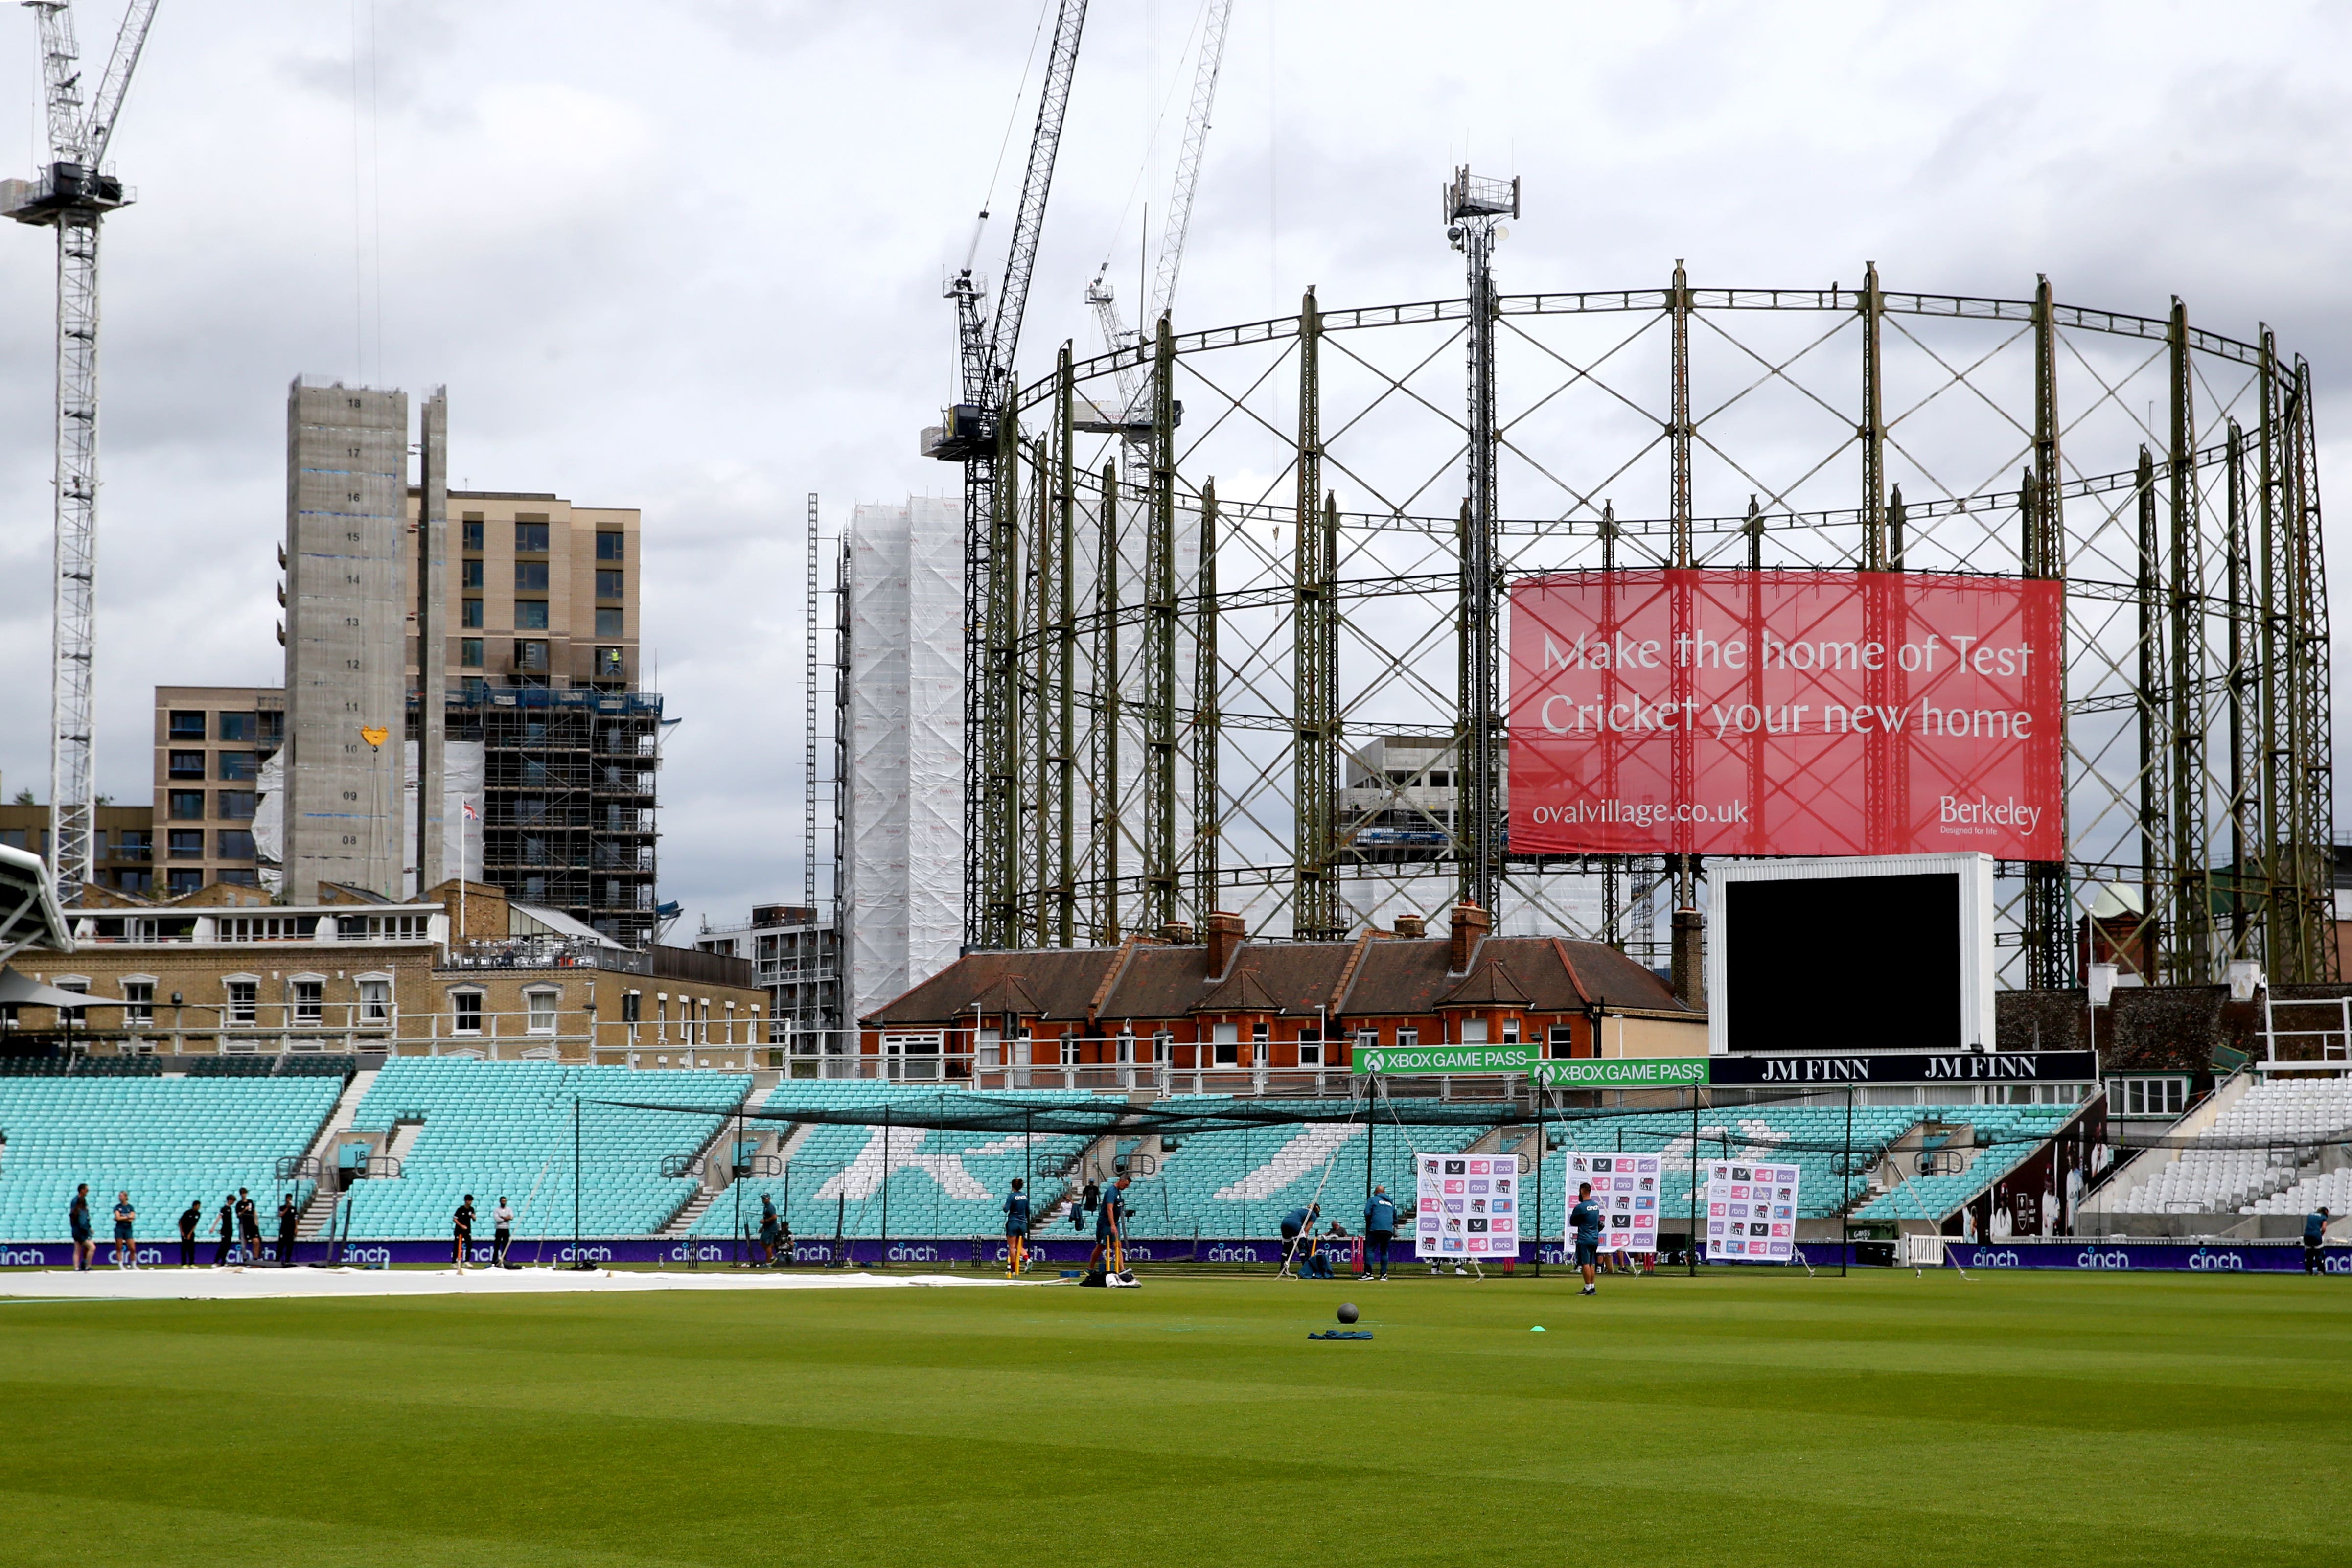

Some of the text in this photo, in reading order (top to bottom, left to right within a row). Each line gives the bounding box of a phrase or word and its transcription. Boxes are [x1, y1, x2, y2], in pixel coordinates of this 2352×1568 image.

[348, 398, 361, 408] 18
[347, 448, 360, 458] 17
[347, 493, 360, 502] 16
[346, 532, 360, 541] 15
[347, 575, 360, 584] 14
[346, 618, 359, 626] 13
[1544, 629, 2034, 677] Make the home of Test
[346, 660, 359, 669] 12
[346, 702, 357, 711] 11
[1541, 693, 2032, 740] Cricket your new home
[345, 744, 357, 753] 10
[343, 791, 357, 801] 09
[1533, 799, 1749, 827] ovalvillage.co.uk
[1940, 795, 2041, 835] Berkeley
[1940, 825, 1973, 835] Designed
[343, 835, 357, 845] 08
[1387, 1051, 1527, 1068] XBOX GAME PASS
[1925, 1056, 2038, 1078] JM FINN
[1559, 1064, 1704, 1081] XBOX GAME PASS
[1762, 1059, 1870, 1081] JM FINN
[354, 1151, 366, 1161] 16
[0, 1245, 45, 1265] inch
[793, 1242, 831, 1261] inch
[888, 1242, 938, 1261] cinch
[1208, 1243, 1257, 1262] cinch
[1973, 1246, 2019, 1267] cinch
[2078, 1246, 2129, 1268] cinch
[2189, 1248, 2243, 1270] cinch
